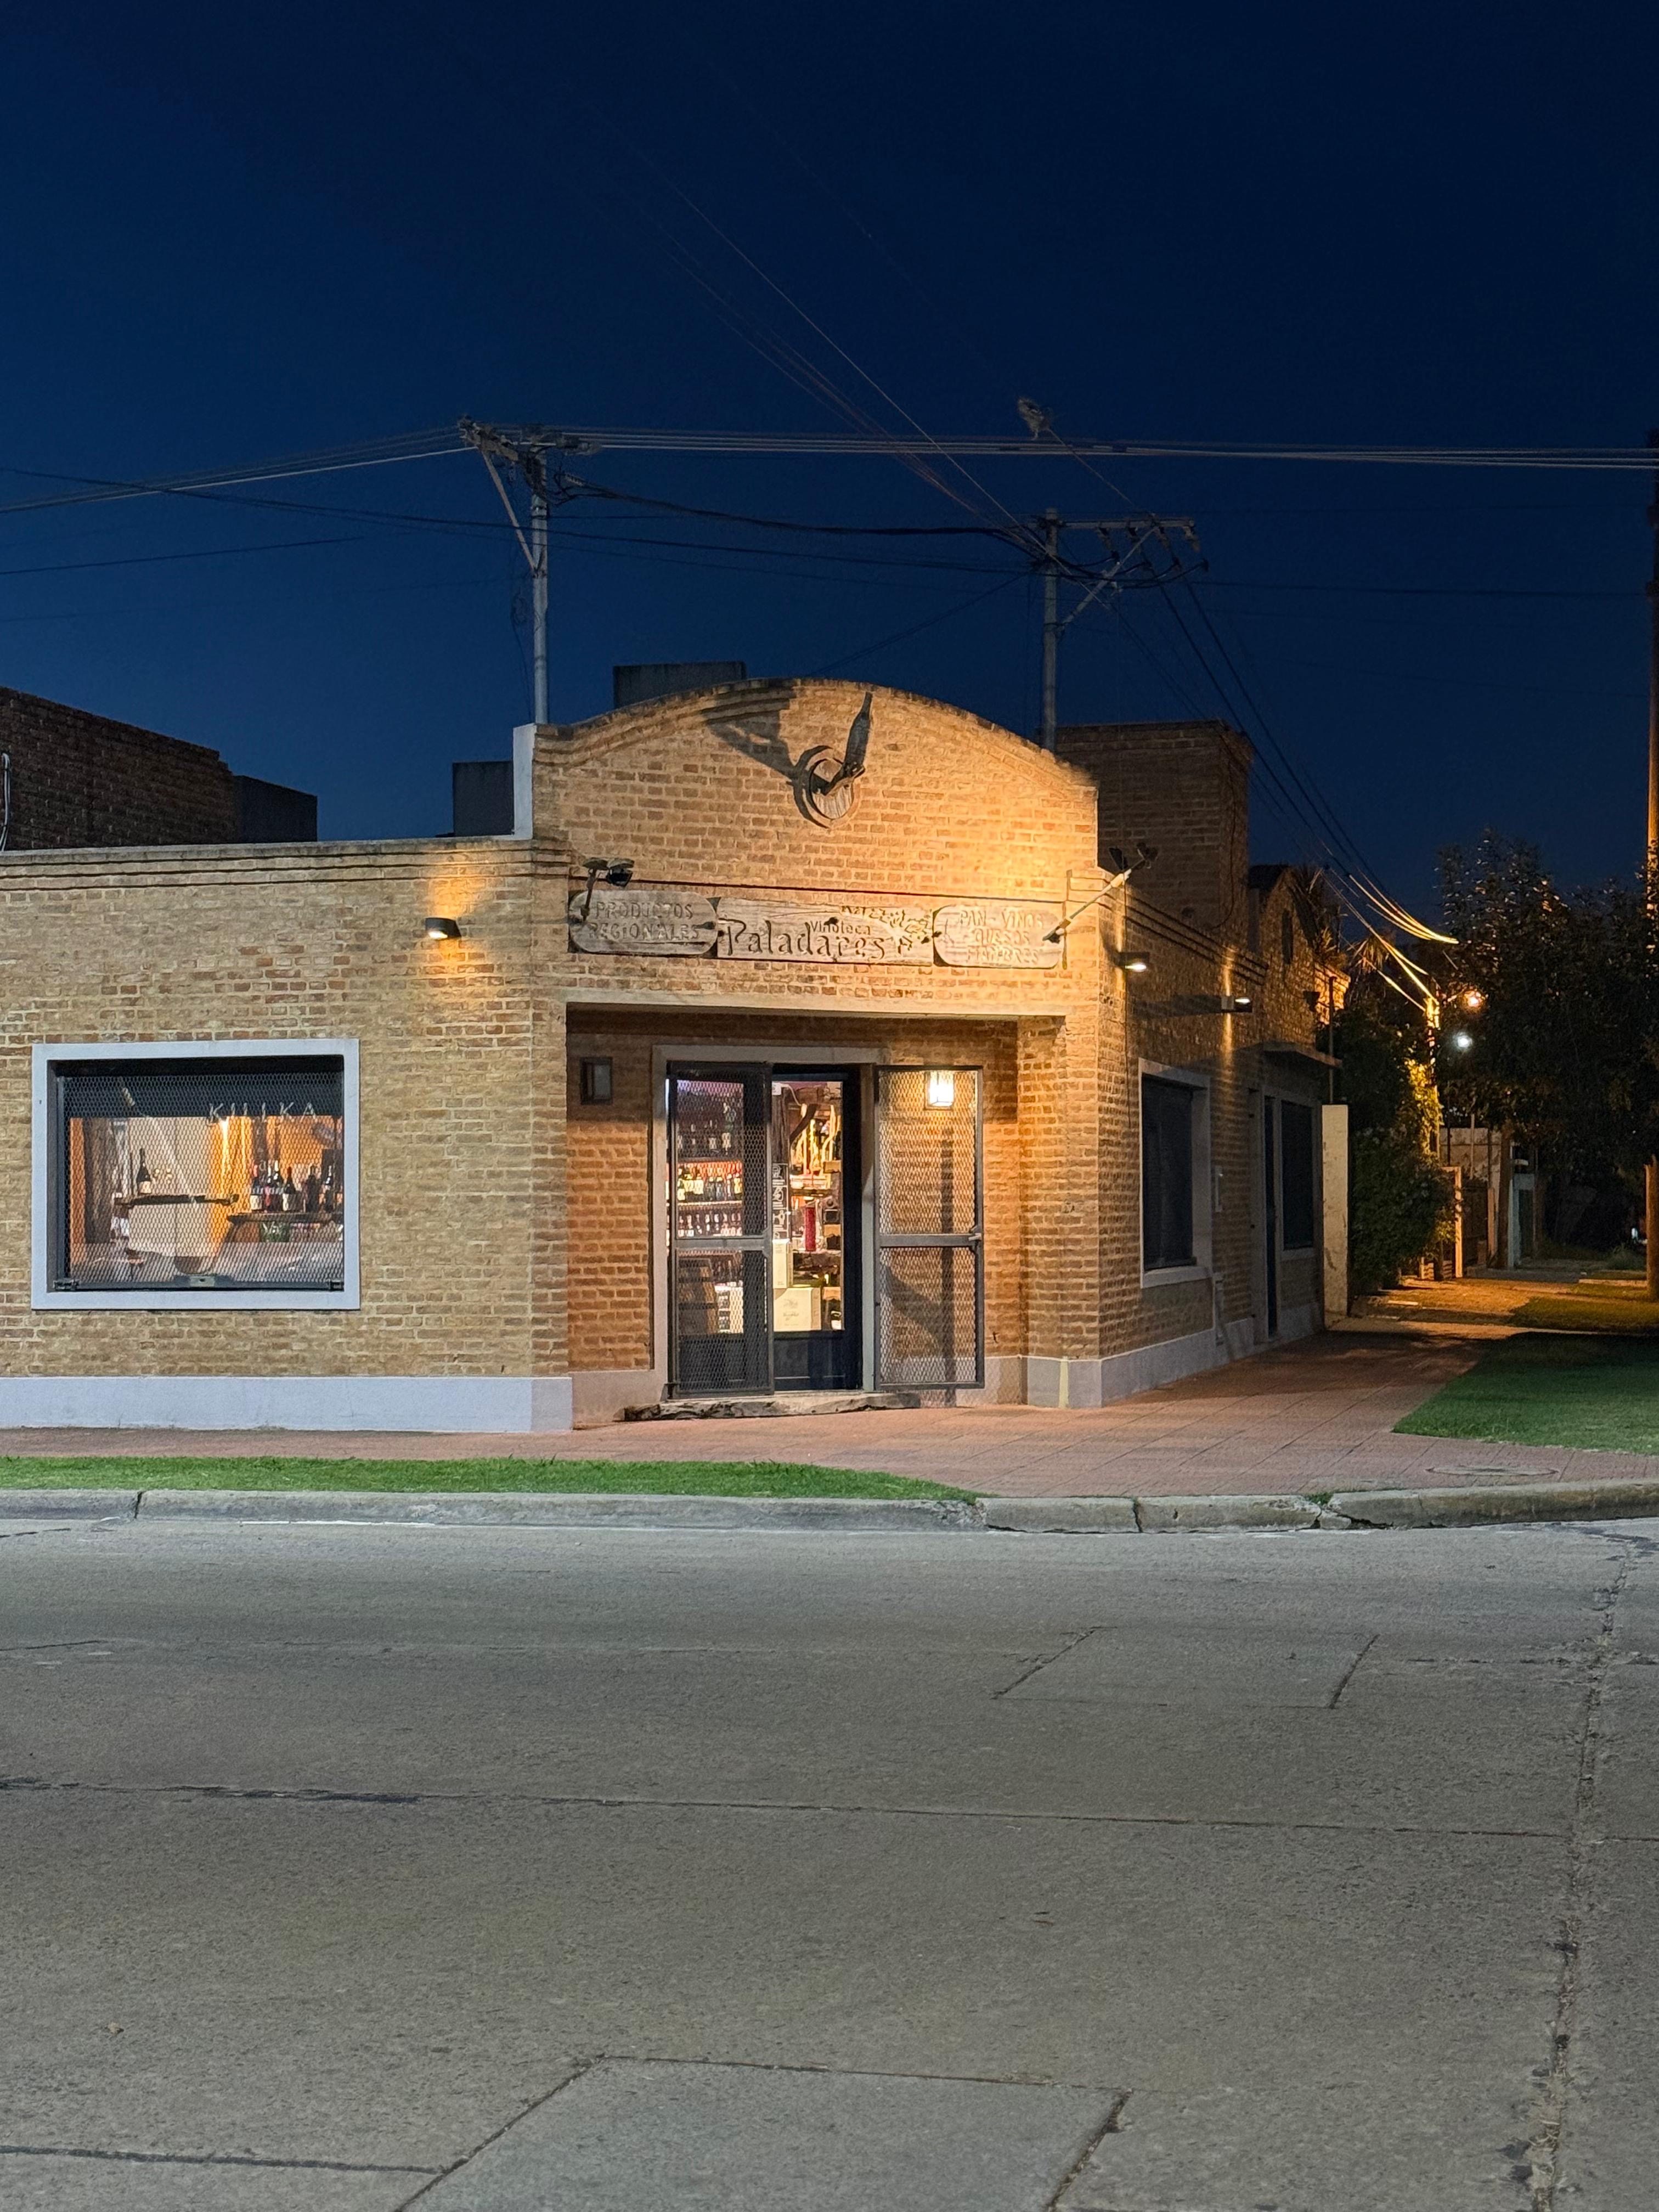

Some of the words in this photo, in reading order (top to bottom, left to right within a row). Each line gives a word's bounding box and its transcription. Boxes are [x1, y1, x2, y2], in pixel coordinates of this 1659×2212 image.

[596, 901, 694, 920] PRODUCTOS
[960, 909, 986, 927] PAN
[1000, 910, 1045, 930] VINOS
[718, 918, 884, 959] Paladares
[974, 928, 1030, 947] QUESOS
